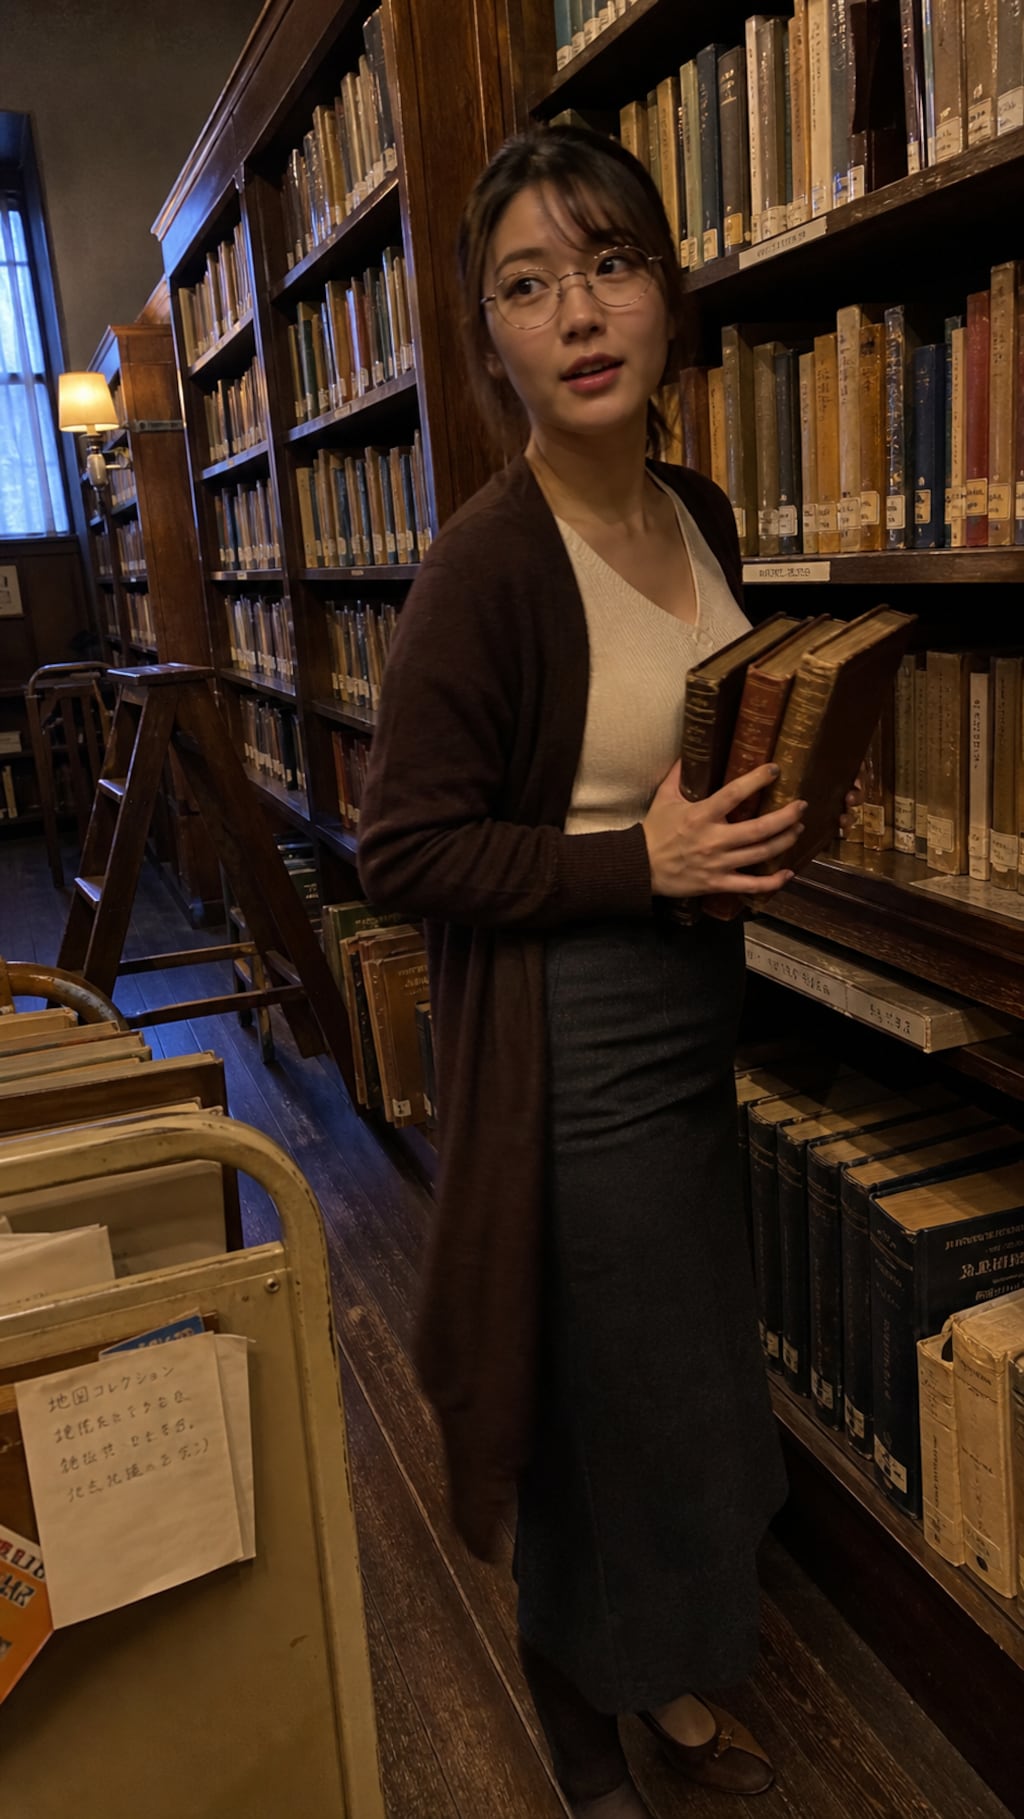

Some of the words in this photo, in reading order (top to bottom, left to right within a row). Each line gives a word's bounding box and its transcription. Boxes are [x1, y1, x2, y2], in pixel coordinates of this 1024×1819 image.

[48, 1366, 175, 1412] 地図コレクション
